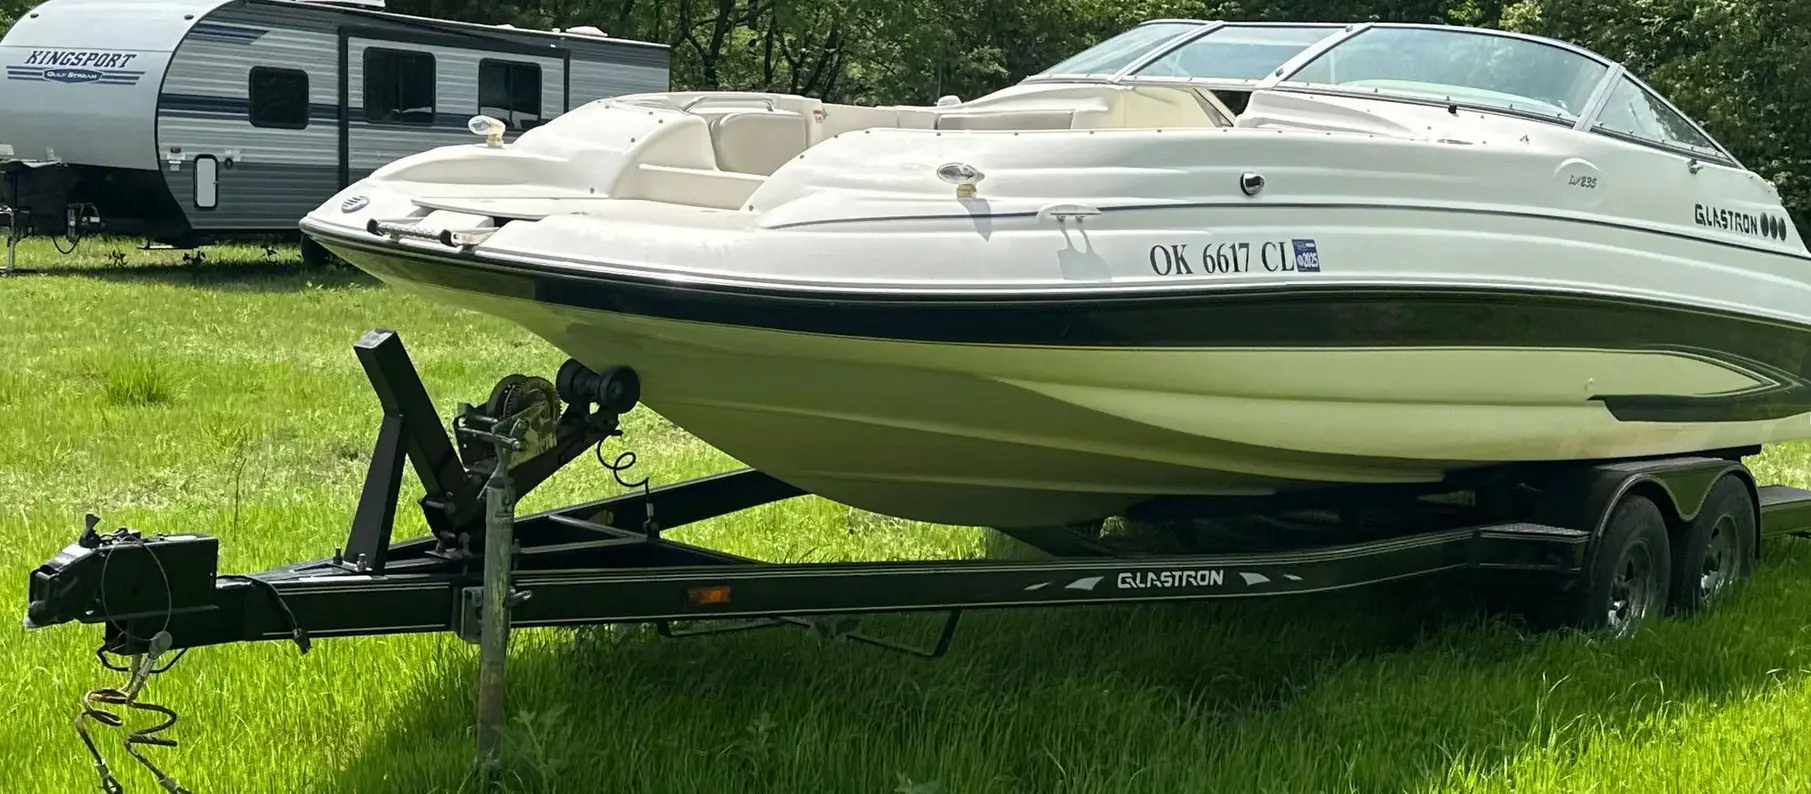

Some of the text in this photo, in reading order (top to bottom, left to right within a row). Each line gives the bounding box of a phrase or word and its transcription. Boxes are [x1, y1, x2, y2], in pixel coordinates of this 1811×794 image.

[24, 50, 137, 68] KINGSPORT
[1694, 203, 1758, 235] GLASTRON
[1149, 241, 1295, 276] OK 6617 CL
[1117, 569, 1224, 589] GLASTRON
